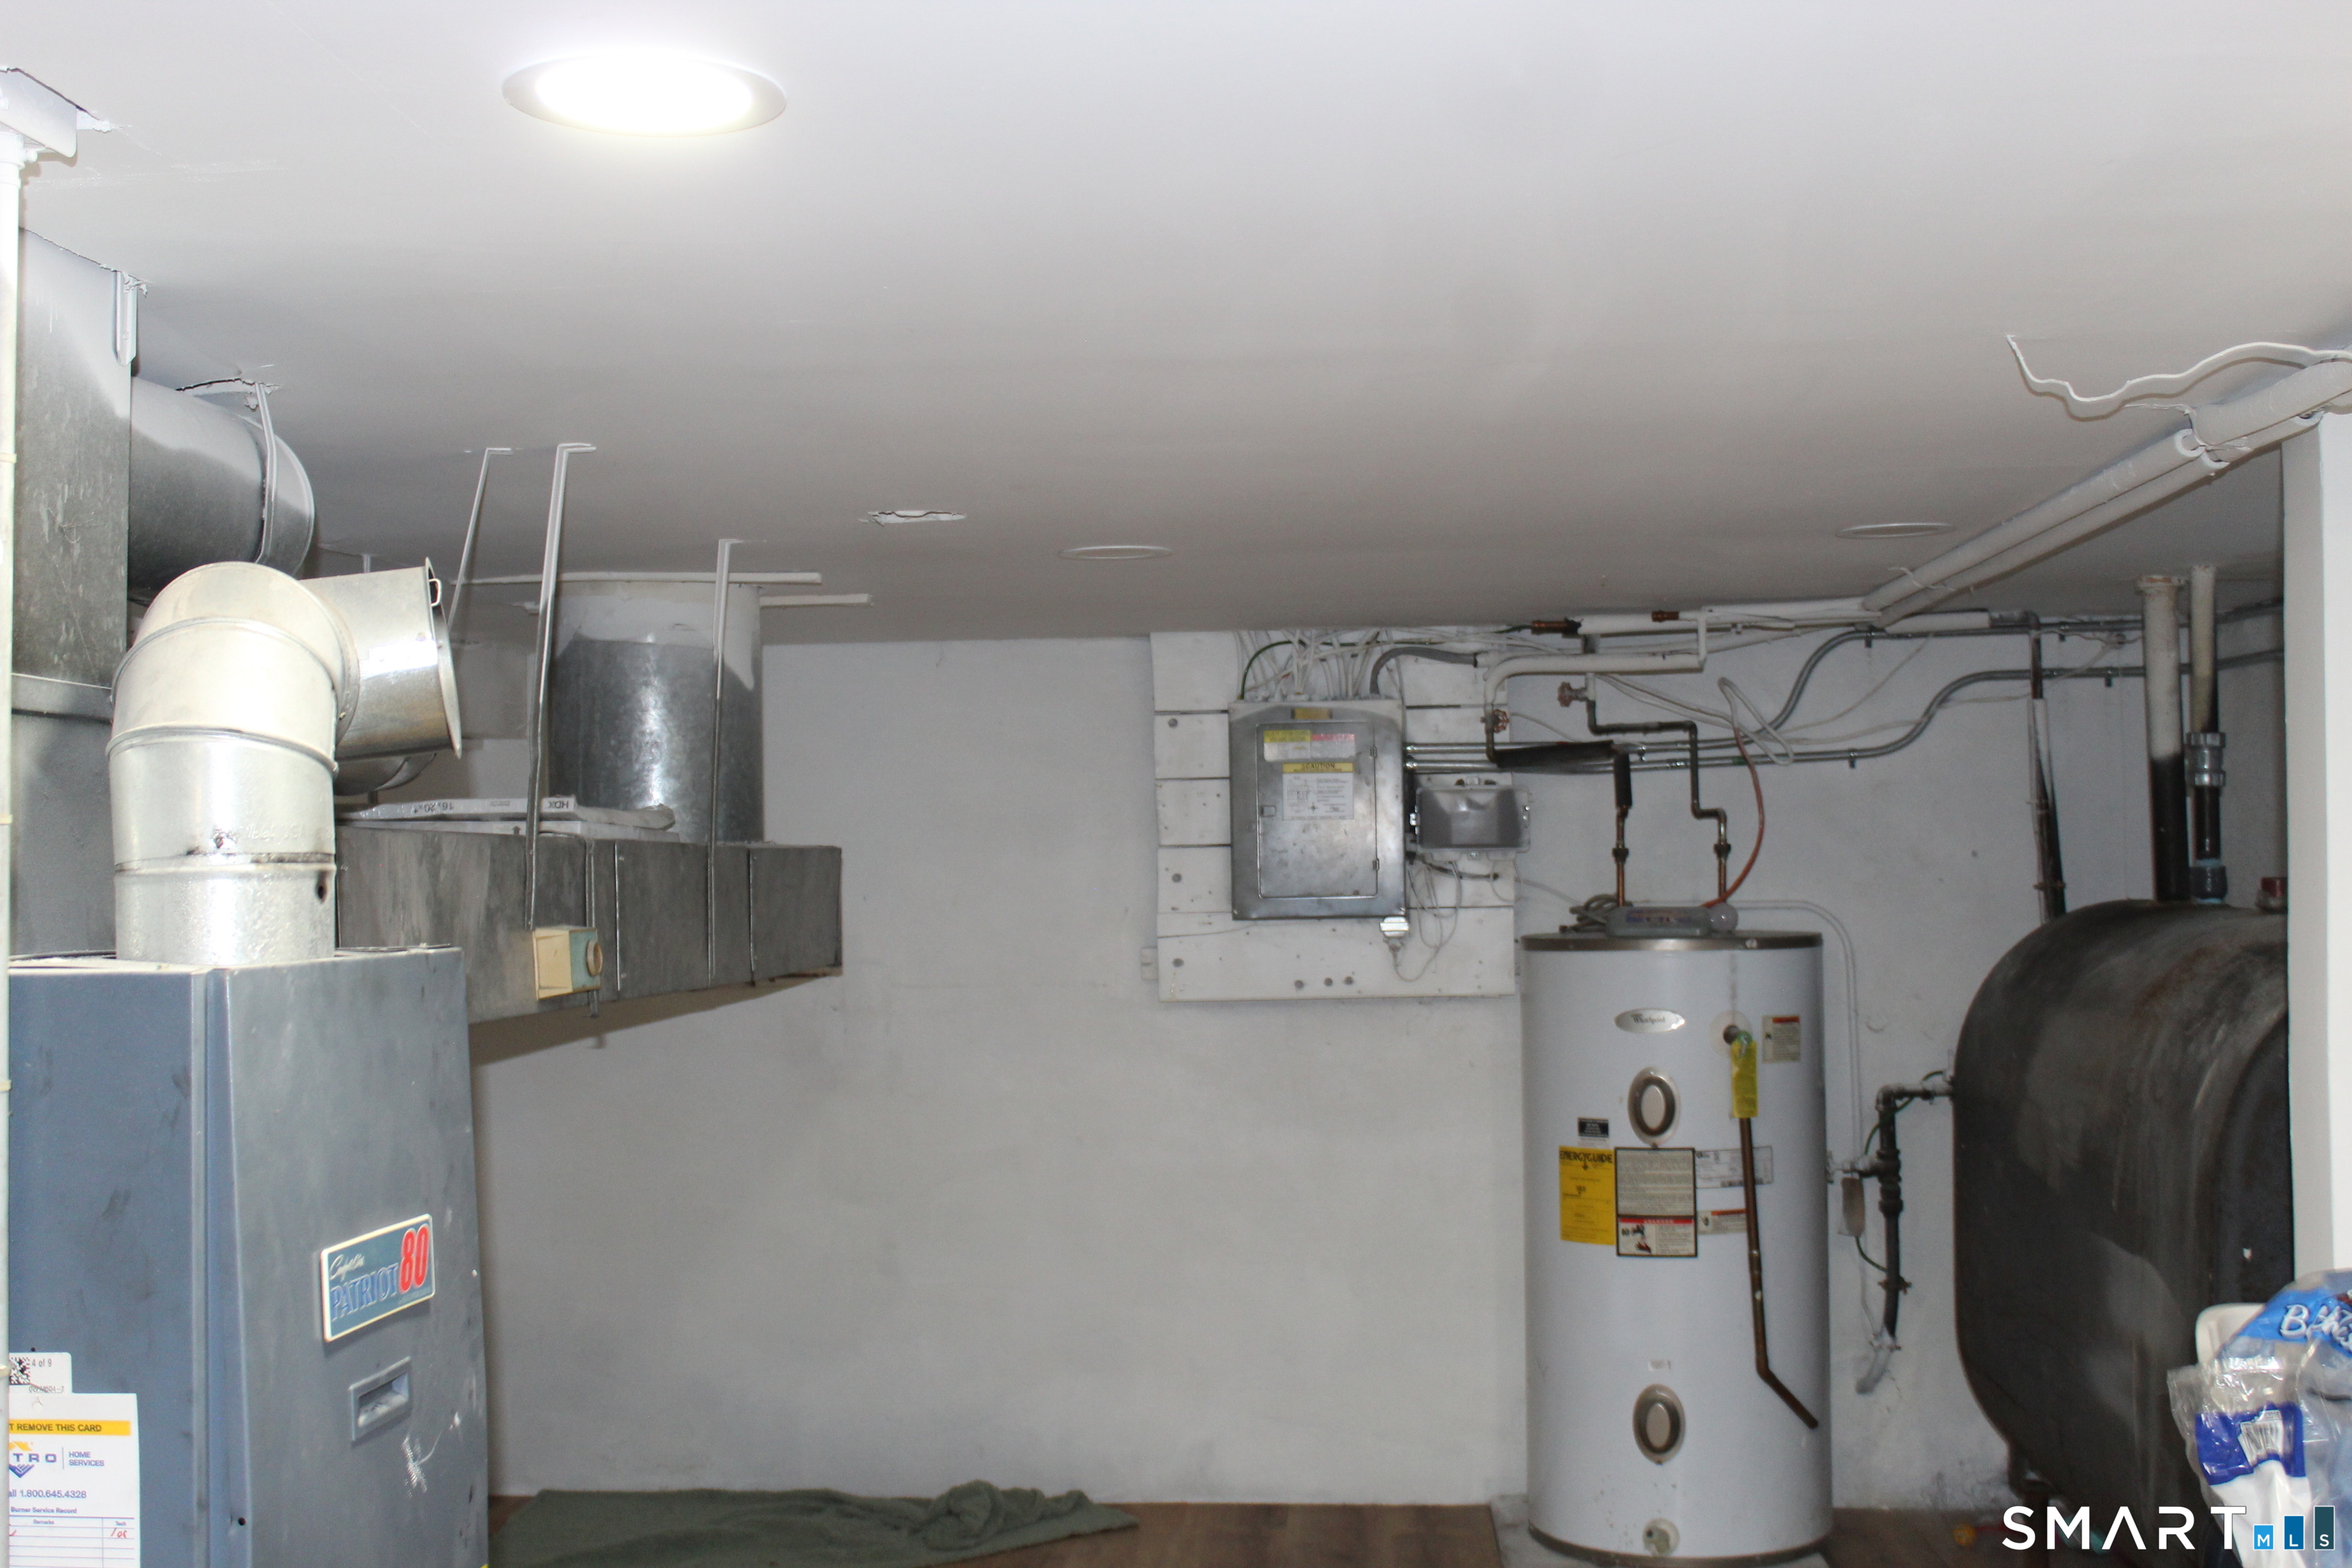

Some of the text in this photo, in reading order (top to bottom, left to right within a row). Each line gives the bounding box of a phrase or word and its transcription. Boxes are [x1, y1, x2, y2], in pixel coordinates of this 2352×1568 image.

[547, 801, 569, 809] HDX
[1632, 1016, 1665, 1024] Whirlpool
[330, 1263, 399, 1322] PATRIOT
[399, 1223, 430, 1294] 80
[31, 1358, 36, 1367] 4
[47, 1358, 52, 1367] 9
[20, 1489, 87, 1498] 1.800.645.4328
